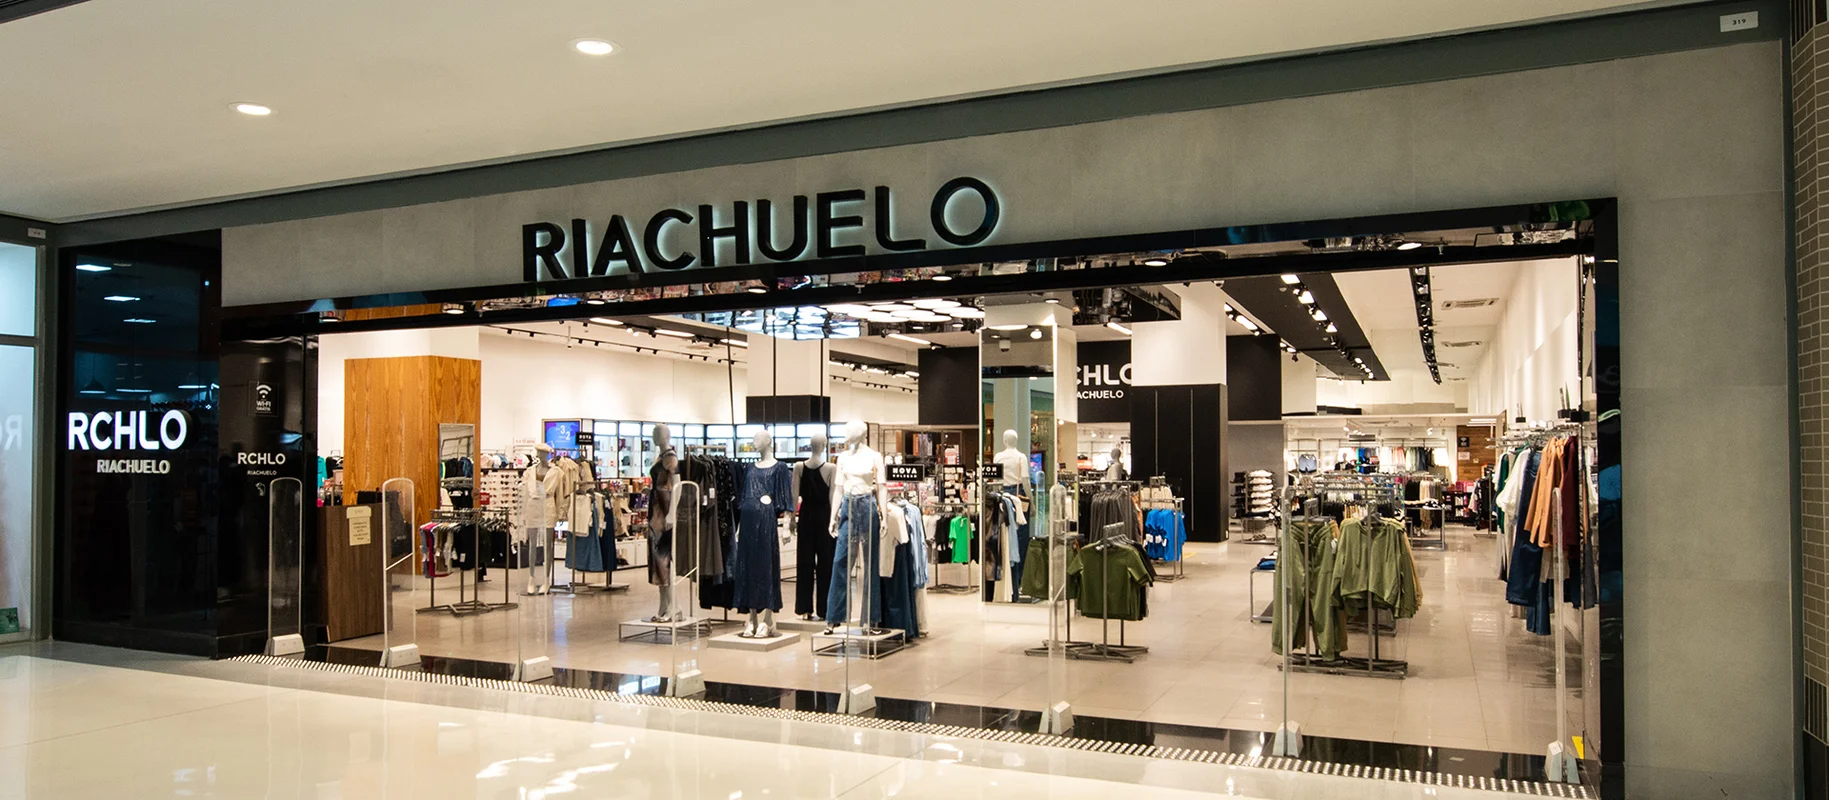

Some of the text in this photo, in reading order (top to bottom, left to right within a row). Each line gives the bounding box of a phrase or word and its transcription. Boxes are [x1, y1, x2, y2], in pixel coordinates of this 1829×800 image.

[522, 176, 1000, 282] RIACHUELO
[68, 409, 187, 450] RCHLO
[560, 424, 566, 435] 3
[565, 431, 571, 441] 2
[237, 452, 286, 465] RCHLO
[96, 459, 171, 474] RIACHUELO
